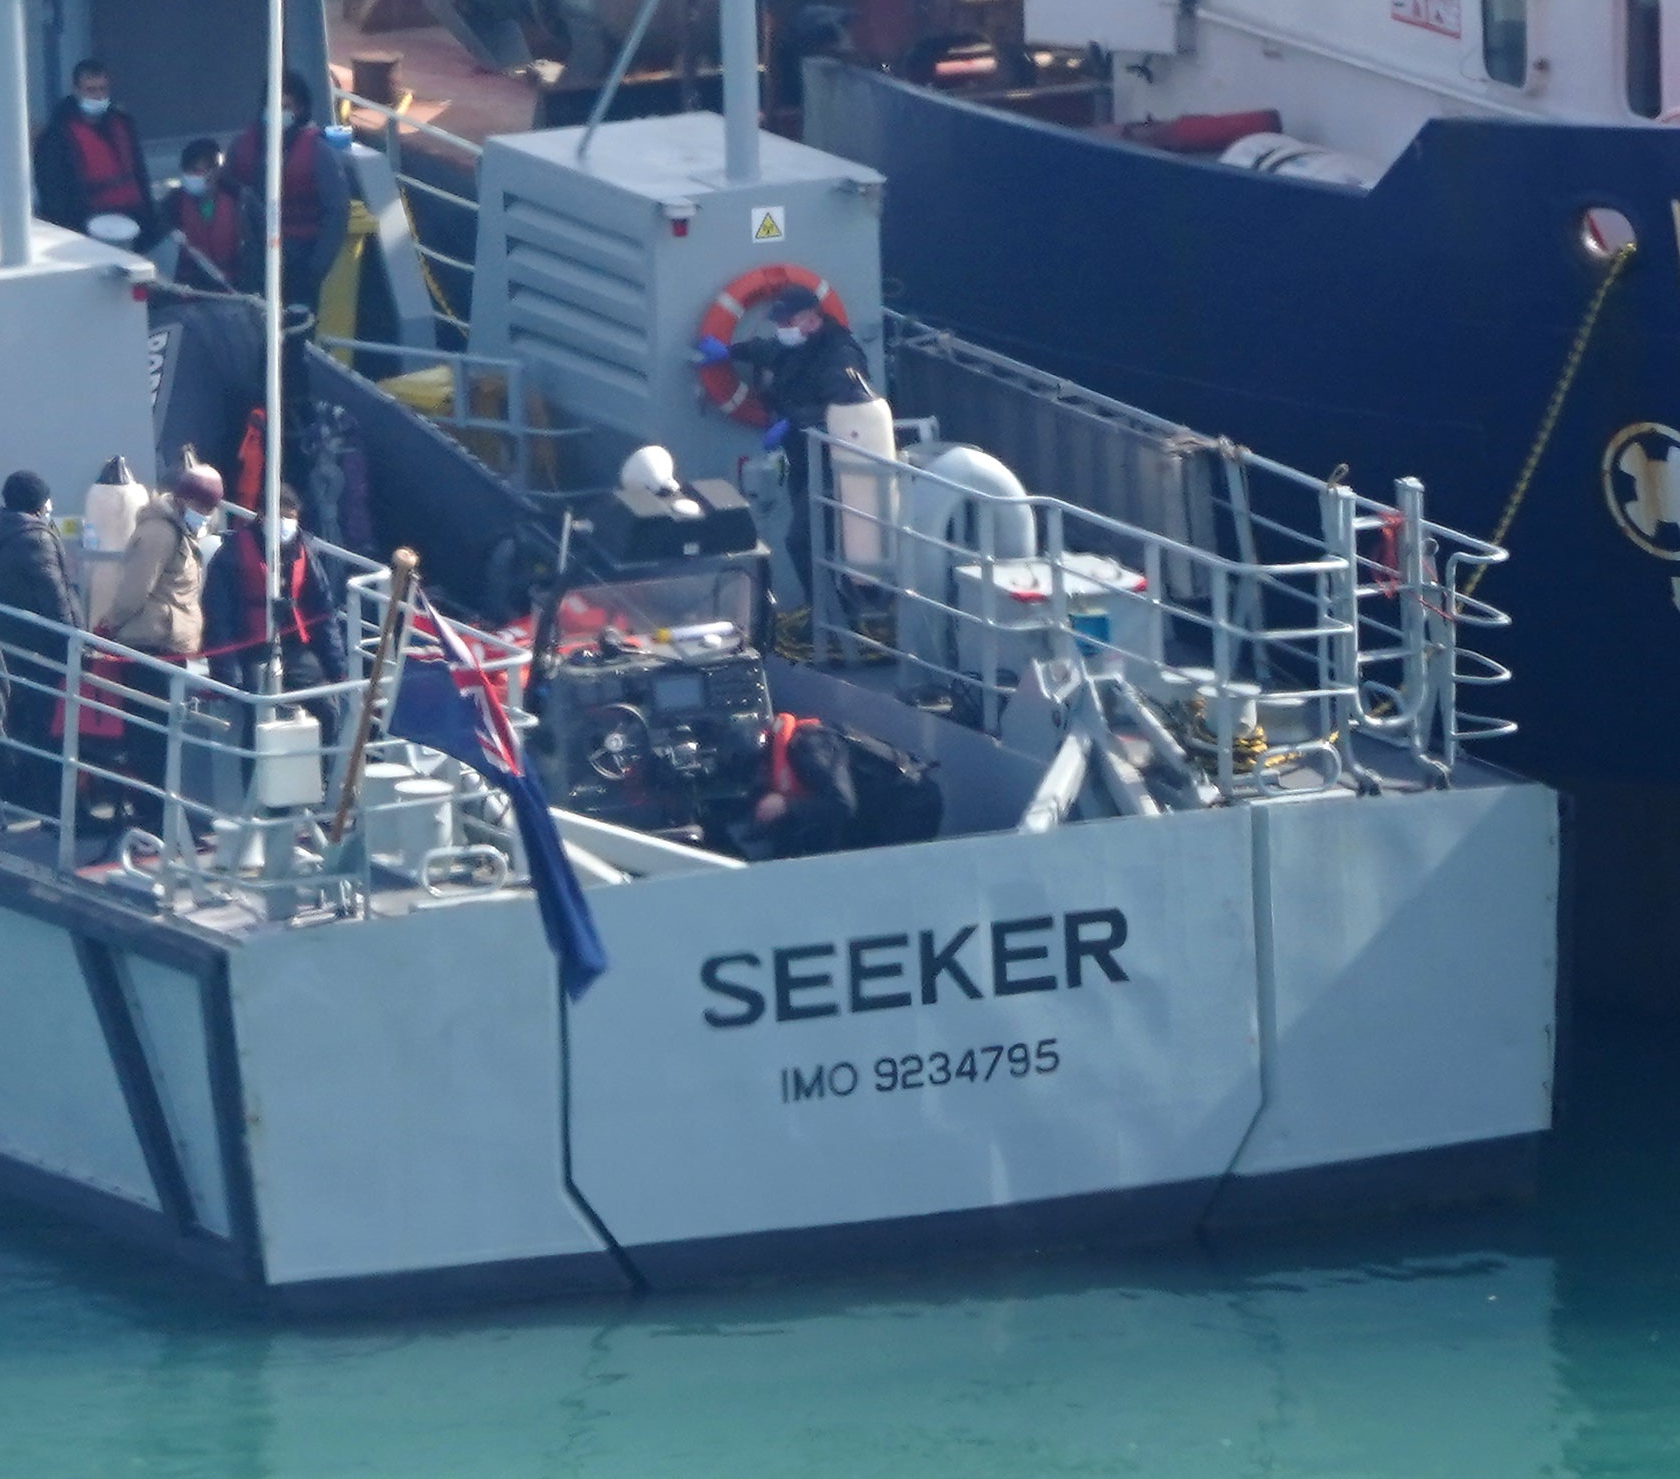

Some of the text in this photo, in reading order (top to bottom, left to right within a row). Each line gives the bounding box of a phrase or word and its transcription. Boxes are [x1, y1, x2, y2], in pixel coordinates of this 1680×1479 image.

[699, 907, 1130, 1029] SEEKER
[781, 1038, 1061, 1104] IMO 9234795
